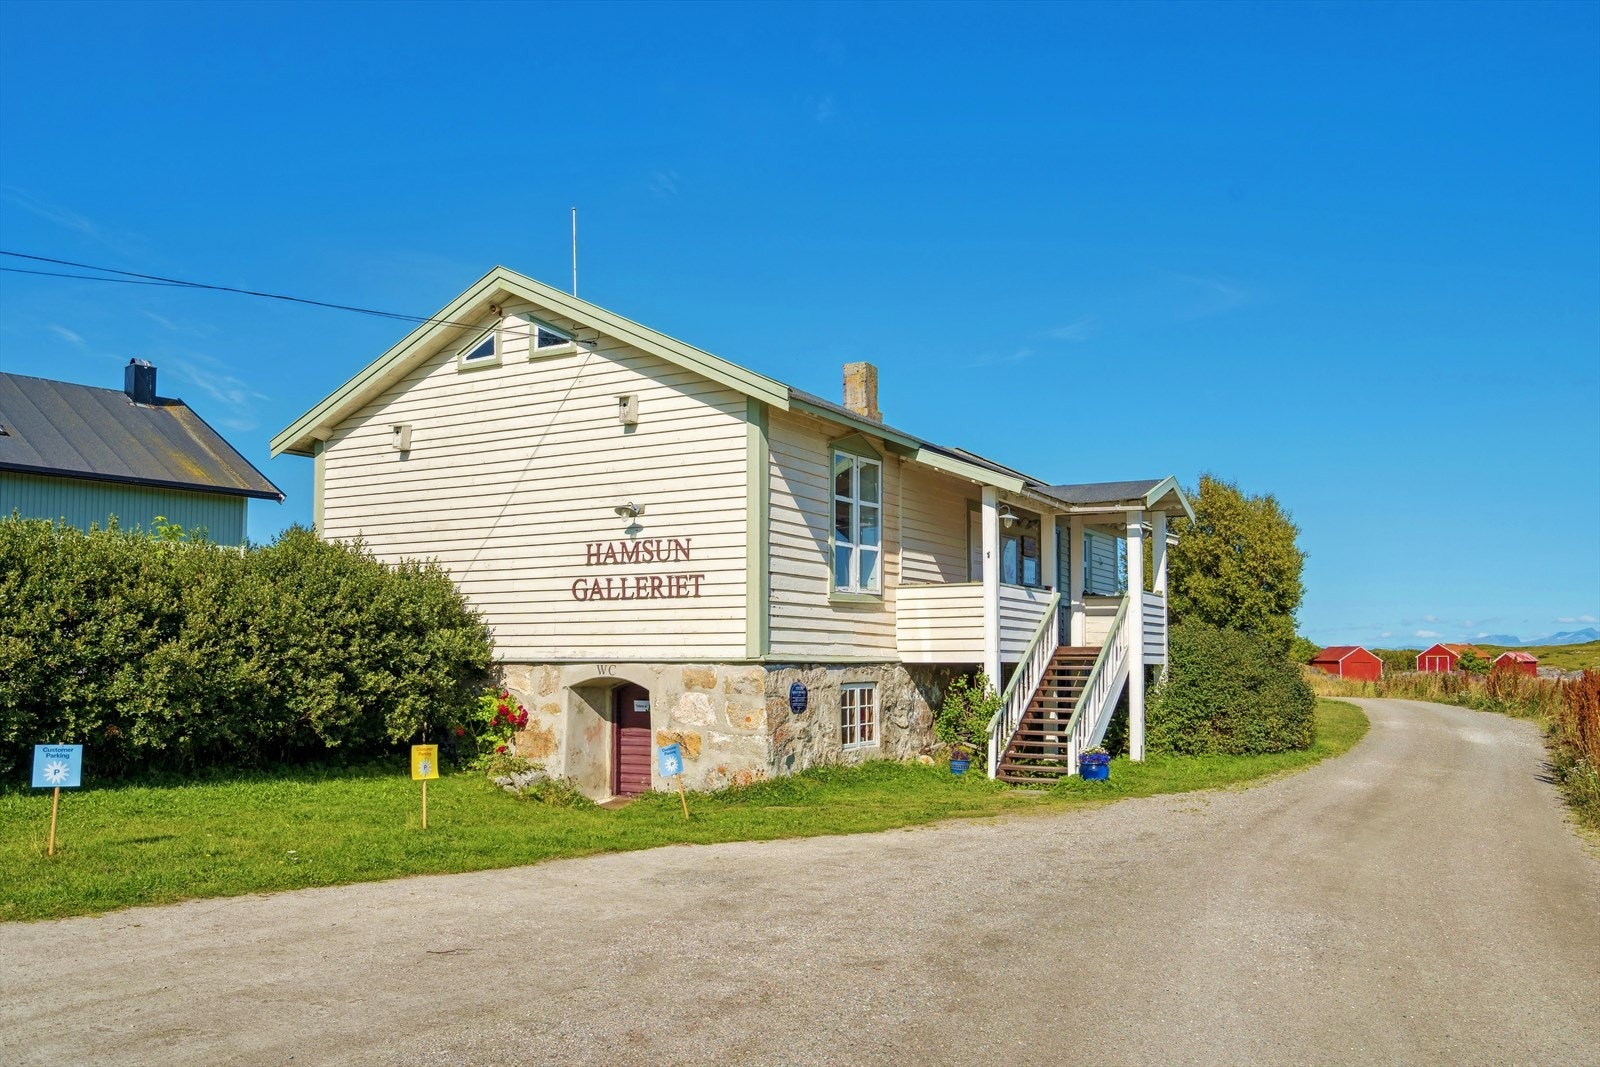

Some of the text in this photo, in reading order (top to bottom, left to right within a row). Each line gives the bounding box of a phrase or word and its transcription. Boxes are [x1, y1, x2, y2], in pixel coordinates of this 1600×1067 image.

[585, 538, 692, 567] HAMSUN
[571, 574, 705, 602] GALLERIET
[596, 664, 617, 676] WC
[45, 752, 70, 760] Parking
